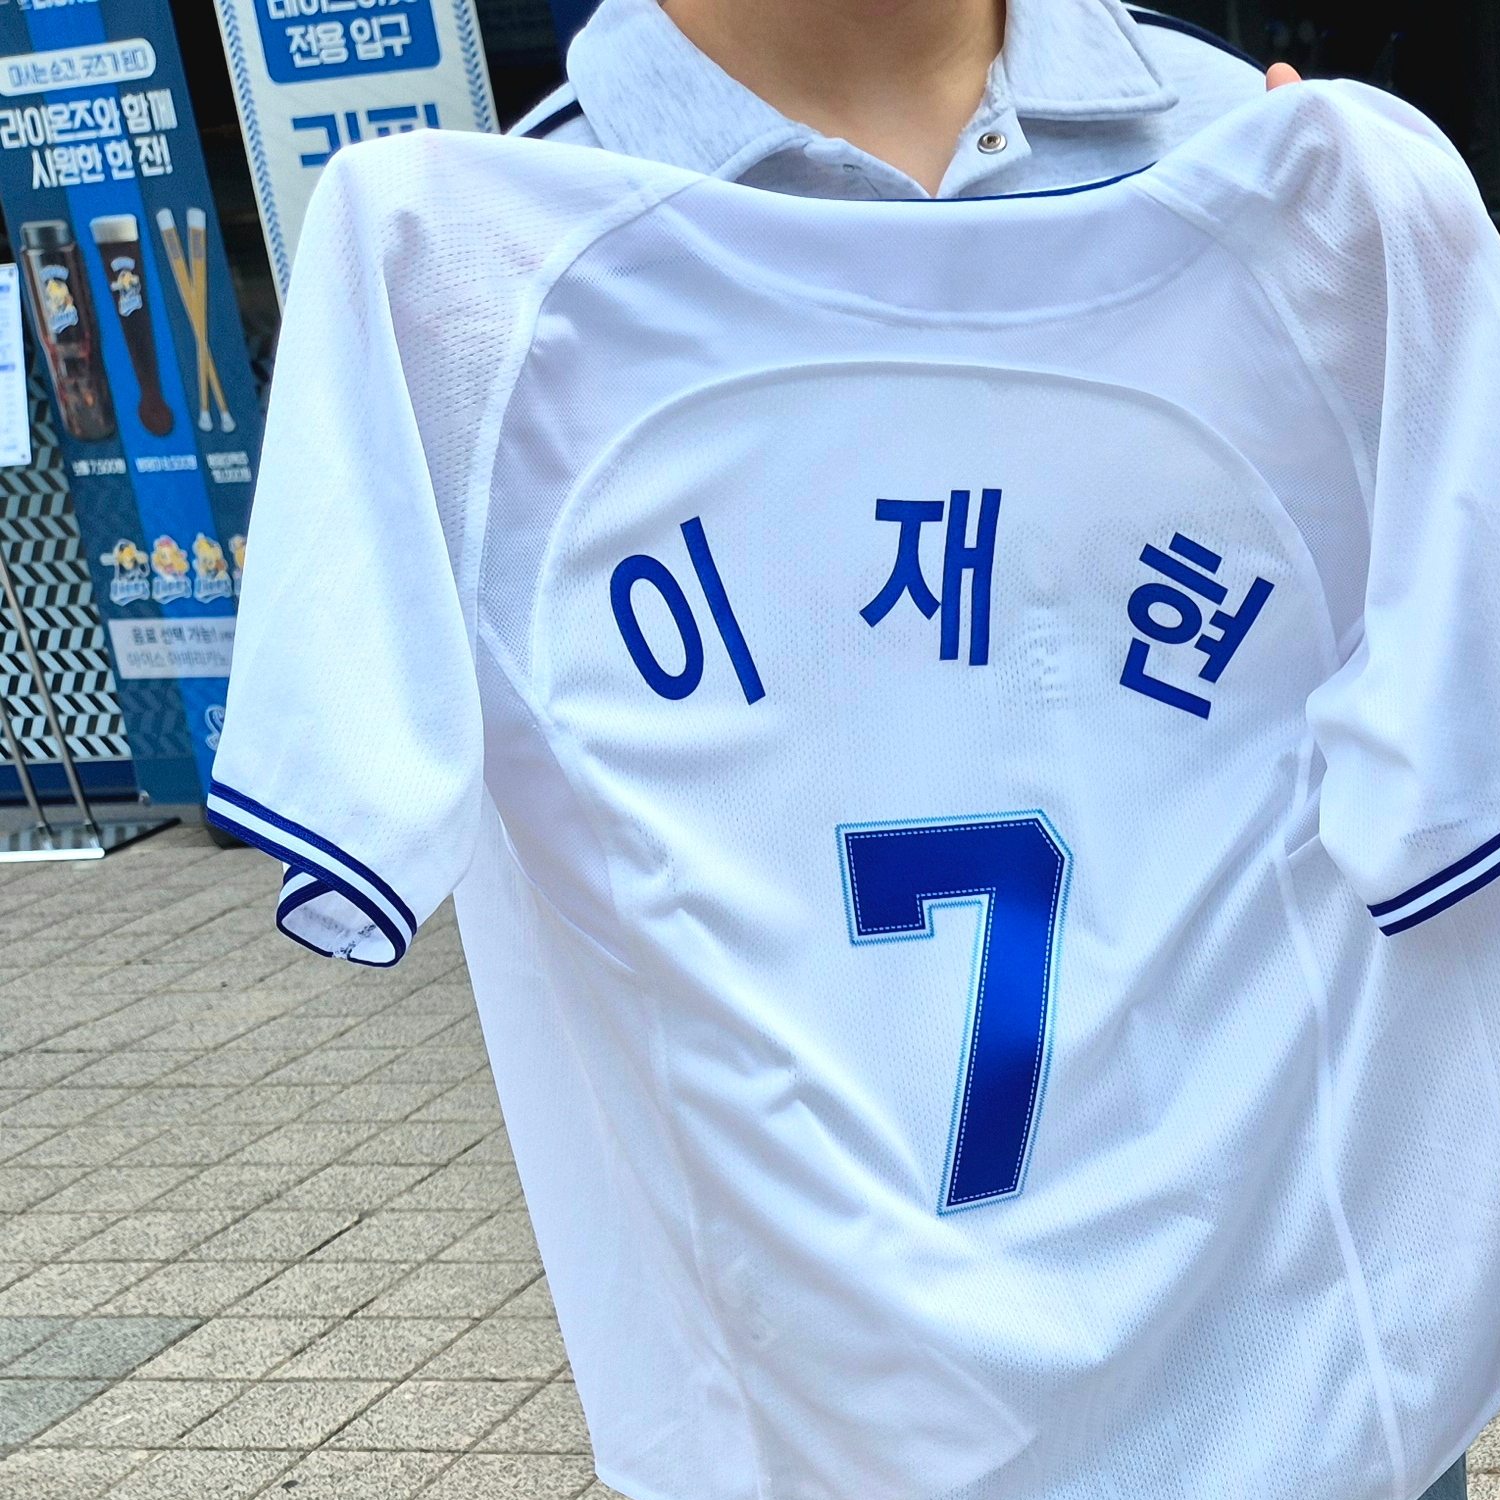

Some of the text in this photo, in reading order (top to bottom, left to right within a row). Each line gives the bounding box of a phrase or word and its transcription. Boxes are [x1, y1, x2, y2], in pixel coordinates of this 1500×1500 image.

[285, 13, 412, 68] 전용 입구
[0, 88, 178, 149] 라이온즈와 함께
[31, 133, 173, 189] 시원한 한 잔!
[836, 809, 1073, 1216] 7
